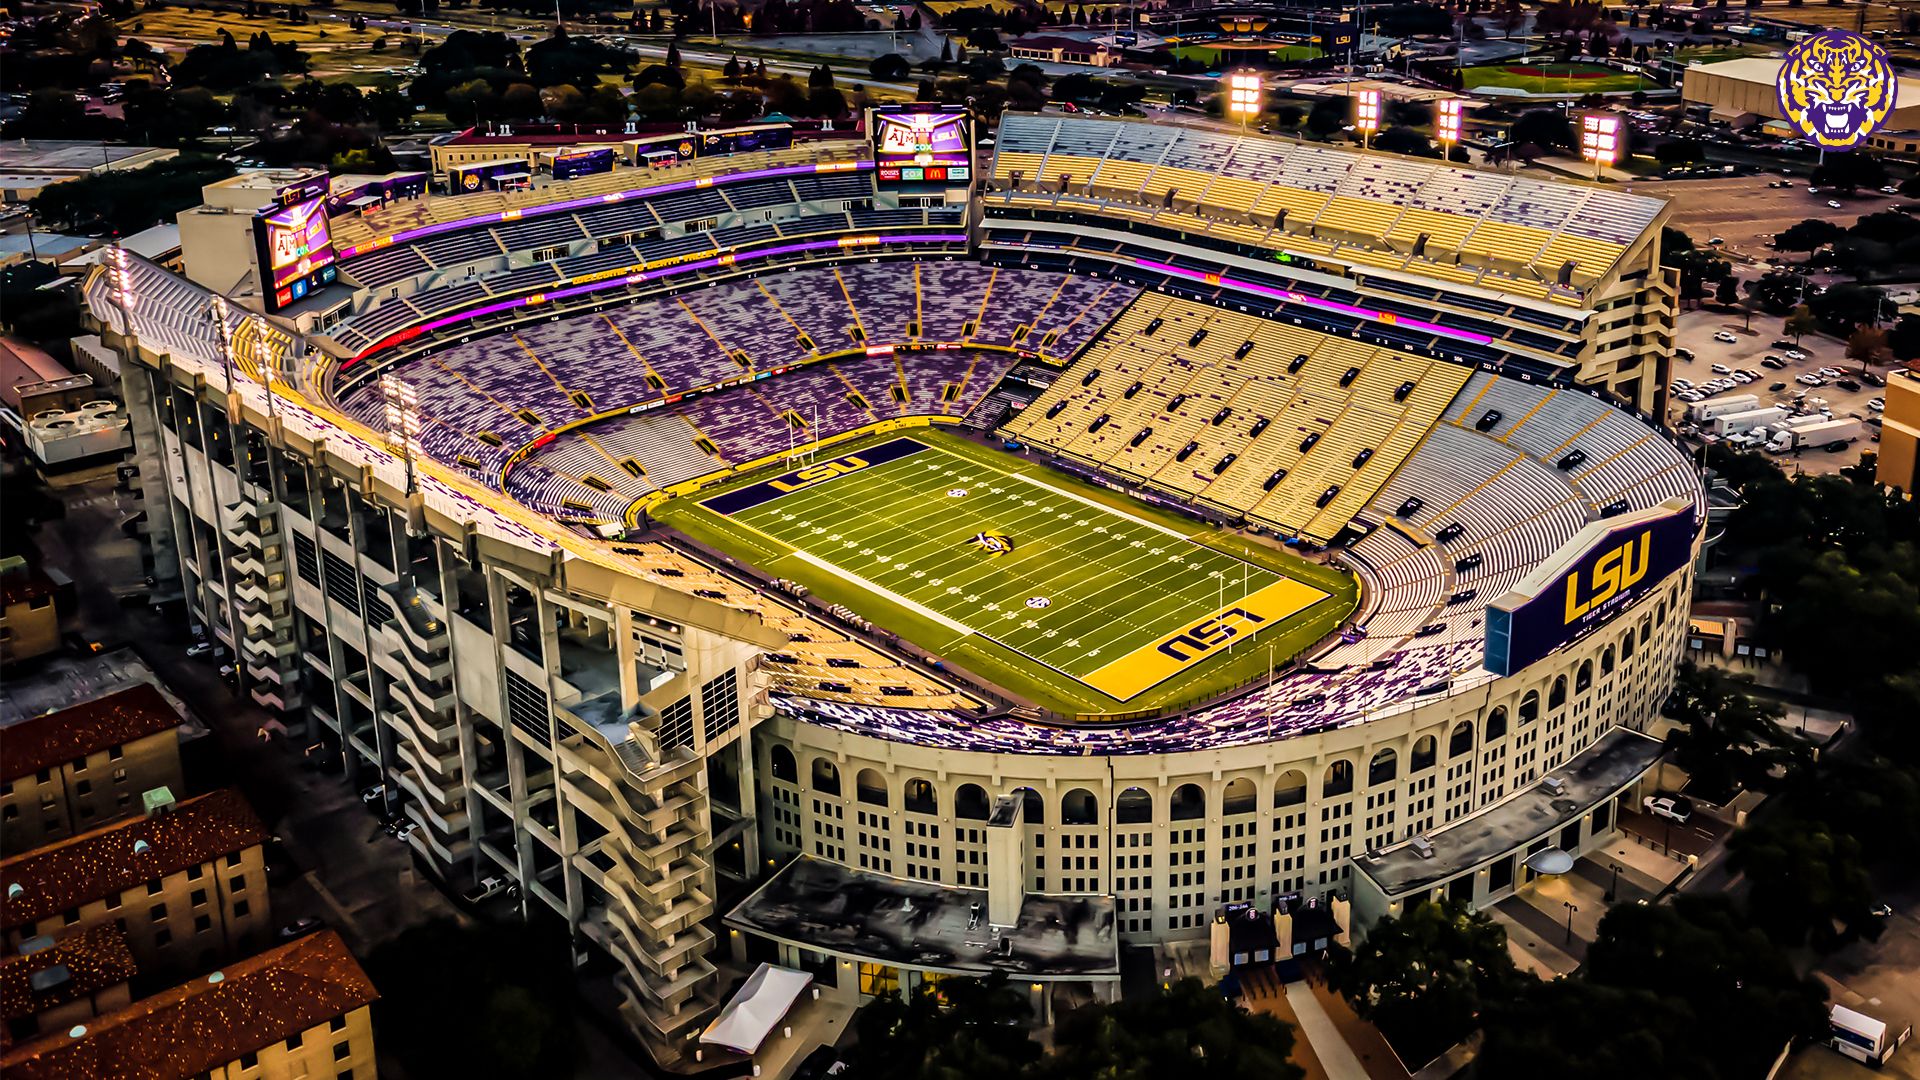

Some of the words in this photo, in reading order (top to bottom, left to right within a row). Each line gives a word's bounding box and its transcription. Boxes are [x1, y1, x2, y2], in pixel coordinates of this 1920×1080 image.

[296, 244, 309, 257] COX
[572, 267, 627, 285] WELCOME
[631, 264, 645, 273] TO
[646, 257, 680, 270] DEATH
[683, 249, 719, 262] VALLEY
[768, 456, 869, 492] LSU
[1564, 530, 1651, 625] LSU
[1582, 607, 1601, 623] TIGER
[1603, 589, 1630, 610] STADIUM
[1157, 607, 1266, 662] LSU
